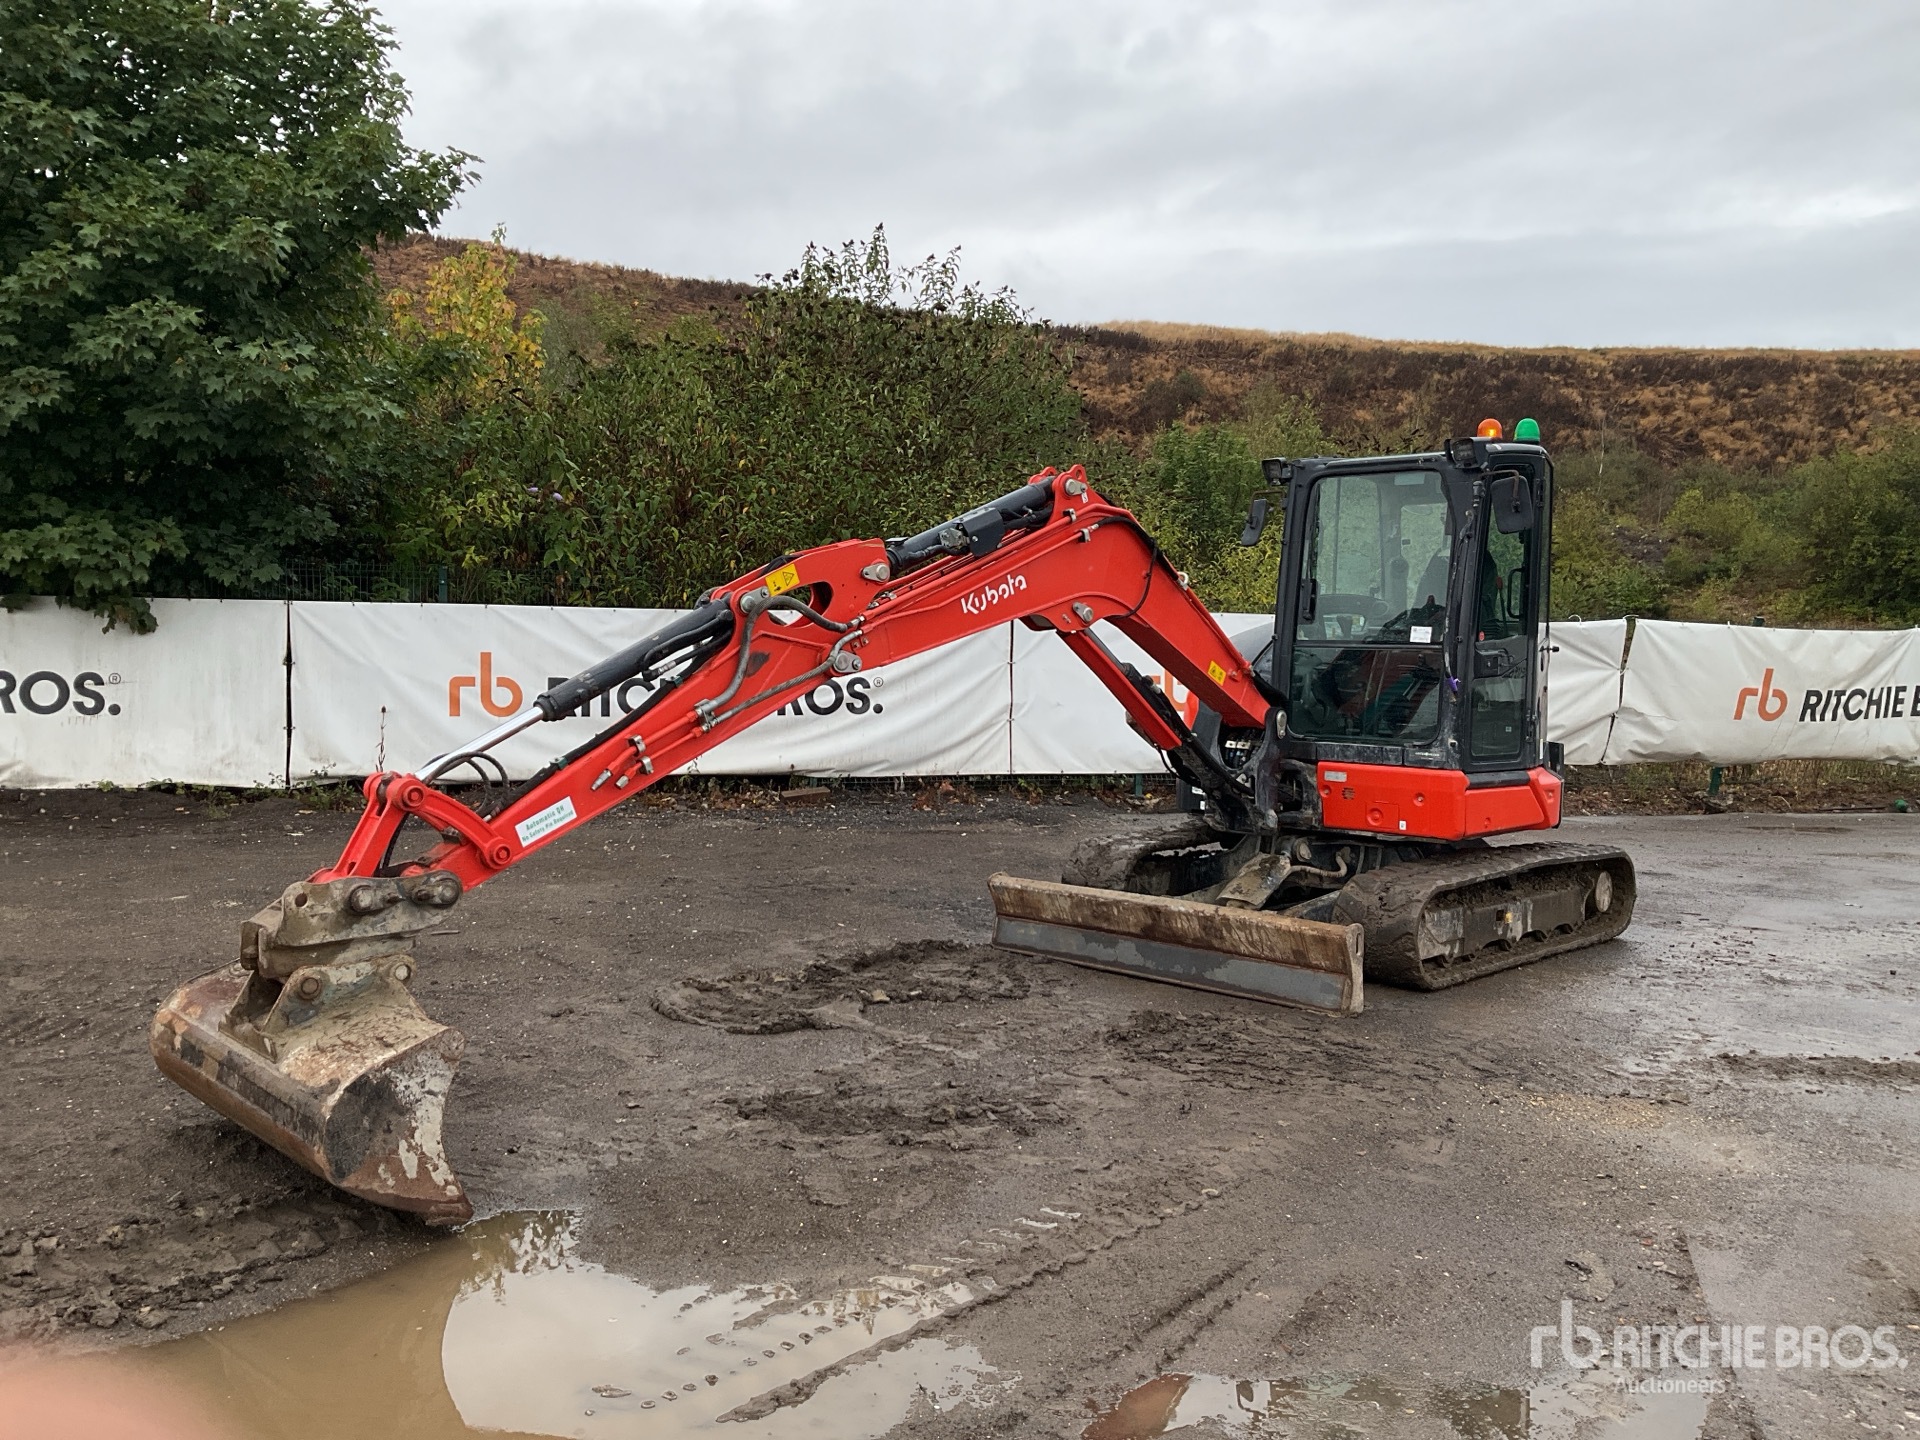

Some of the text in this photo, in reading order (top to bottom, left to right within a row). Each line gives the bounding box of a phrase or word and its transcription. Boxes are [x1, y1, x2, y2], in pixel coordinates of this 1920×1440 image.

[960, 574, 1027, 615] Kubota
[449, 651, 523, 717] rb
[1734, 668, 1788, 721] rb
[1799, 685, 1907, 722] RITCHIE
[525, 811, 555, 830] Automatic
